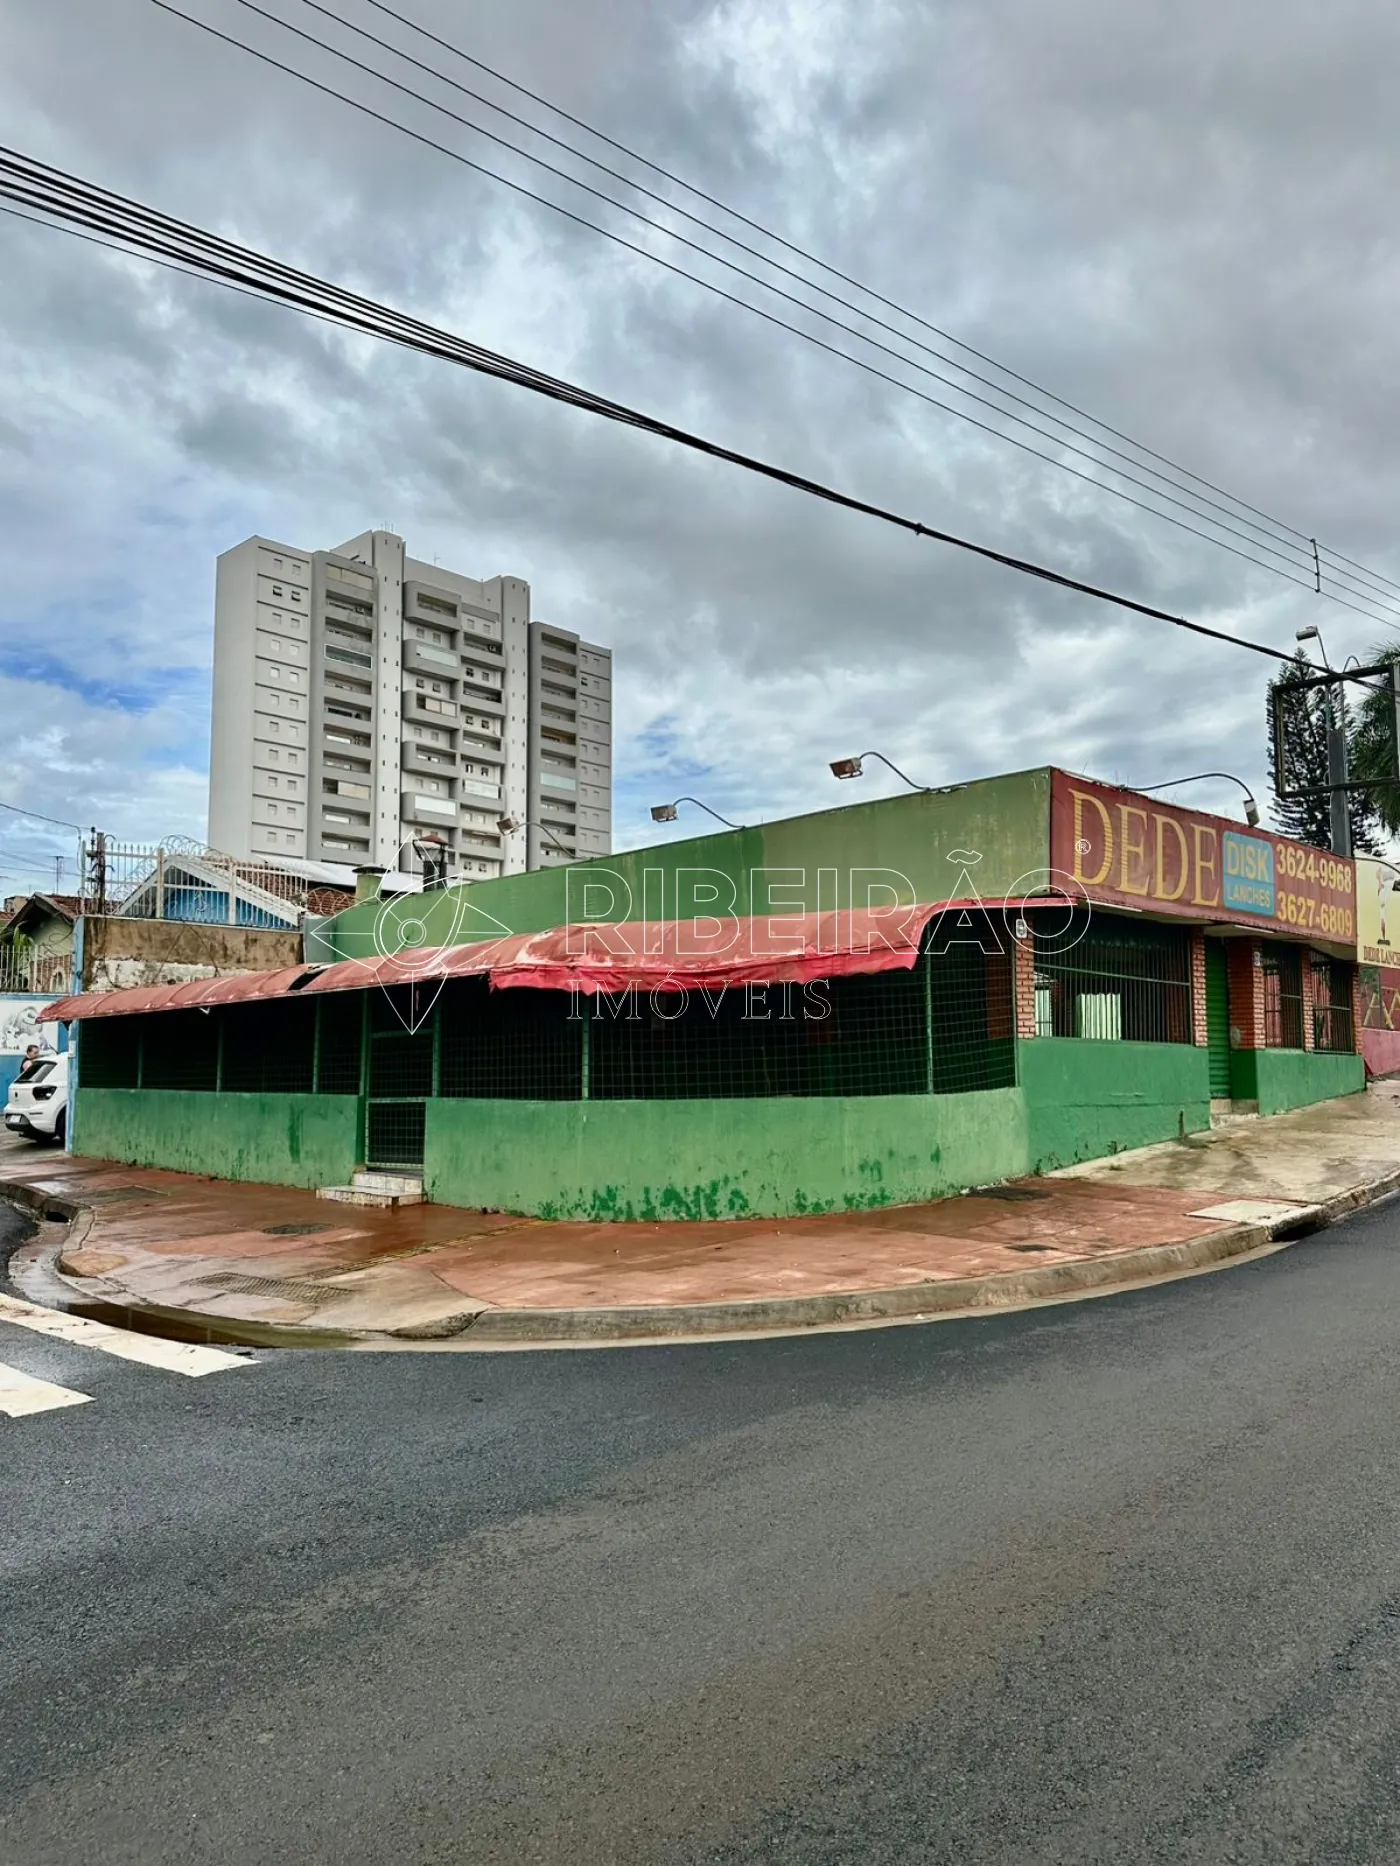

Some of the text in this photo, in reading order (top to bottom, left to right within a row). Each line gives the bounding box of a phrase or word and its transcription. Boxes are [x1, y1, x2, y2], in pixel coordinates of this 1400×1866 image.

[1067, 788, 1220, 907] DEDE
[1226, 840, 1269, 882] DISK
[1276, 843, 1352, 893] 3624-9968
[1228, 883, 1270, 909] LANCHES
[1277, 890, 1353, 937] 3627-6809
